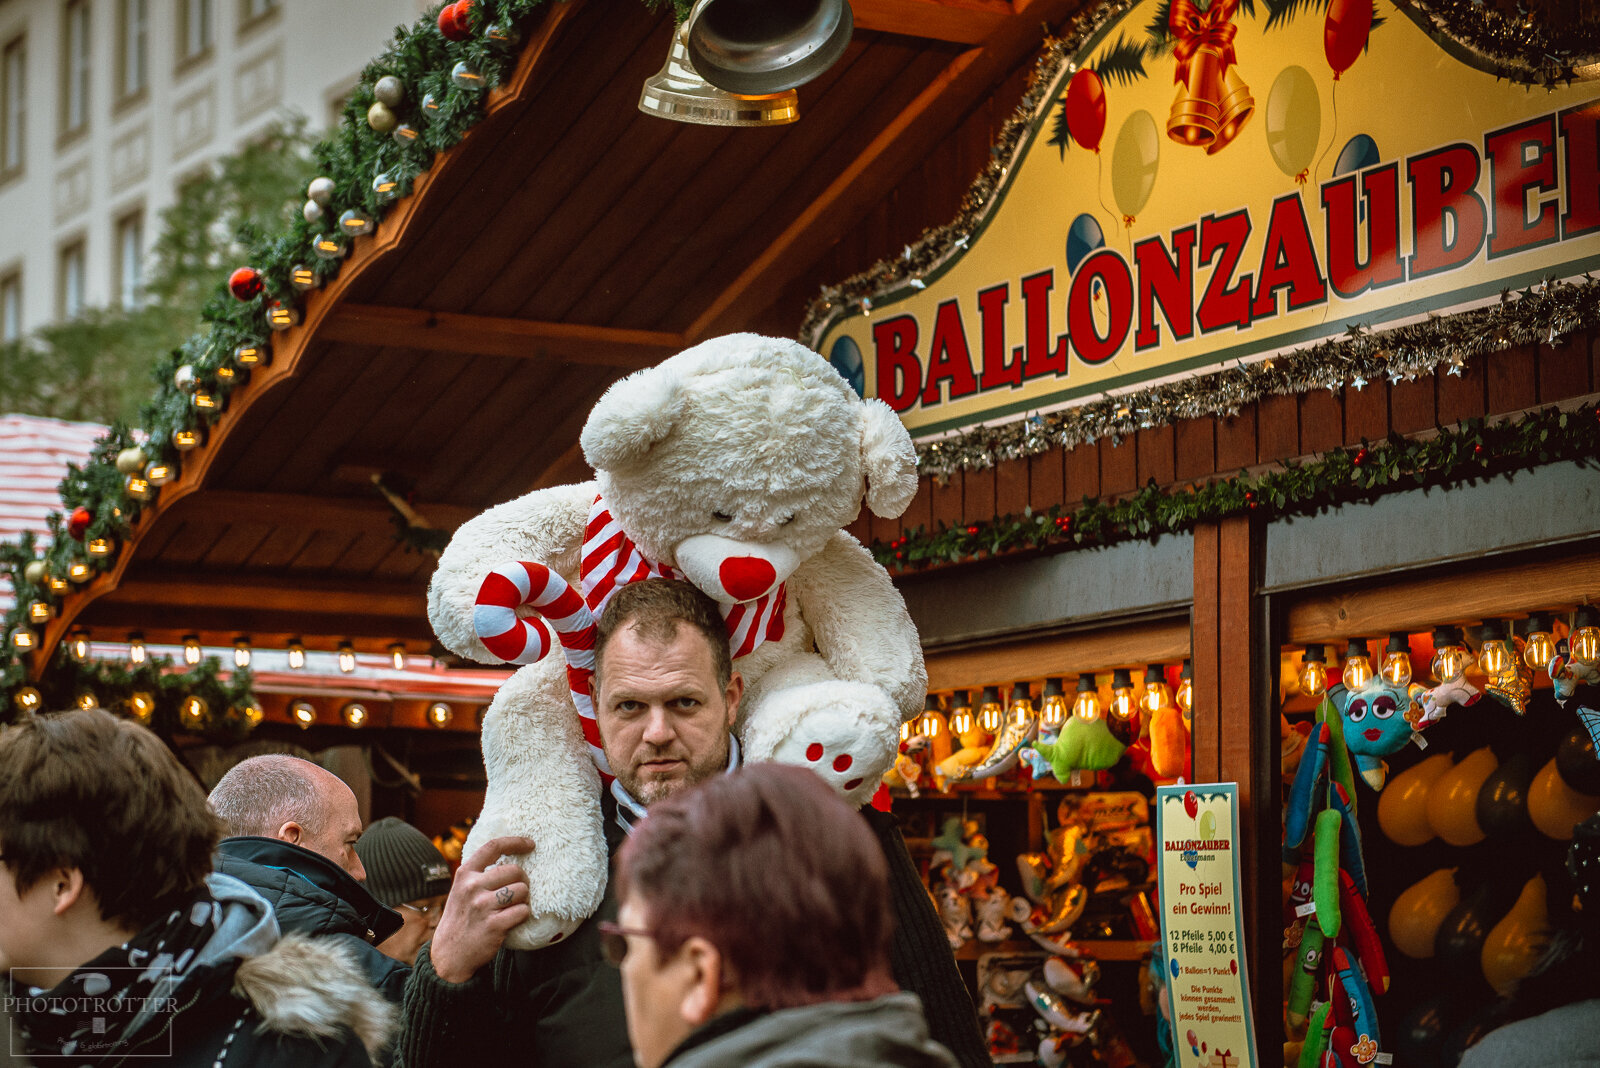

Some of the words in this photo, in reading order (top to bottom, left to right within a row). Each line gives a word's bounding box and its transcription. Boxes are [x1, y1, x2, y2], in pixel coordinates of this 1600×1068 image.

[1165, 840, 1230, 851] BALLONZAUBER
[1180, 883, 1196, 895] Pro
[1199, 882, 1222, 898] Spiel
[1173, 902, 1187, 915] ein
[1190, 902, 1231, 915] Gewinn!
[1170, 930, 1179, 940] 12
[1182, 930, 1204, 941] Pfeile
[1208, 931, 1226, 942] 5,00
[1228, 931, 1234, 941] €
[1173, 943, 1178, 953] 8
[1180, 942, 1203, 953] Pfeile
[1209, 943, 1227, 955] 4,00
[1230, 944, 1235, 954] €
[1180, 966, 1184, 974] 1
[1213, 967, 1231, 976] Punkt
[1191, 985, 1201, 993] Die
[1202, 985, 1223, 994] Punkte
[1181, 994, 1202, 1002] können
[1204, 996, 1236, 1005] gesammelt
[1197, 1004, 1221, 1013] werden,
[1179, 1012, 1194, 1021] jedes
[1196, 1013, 1210, 1022] Spiel
